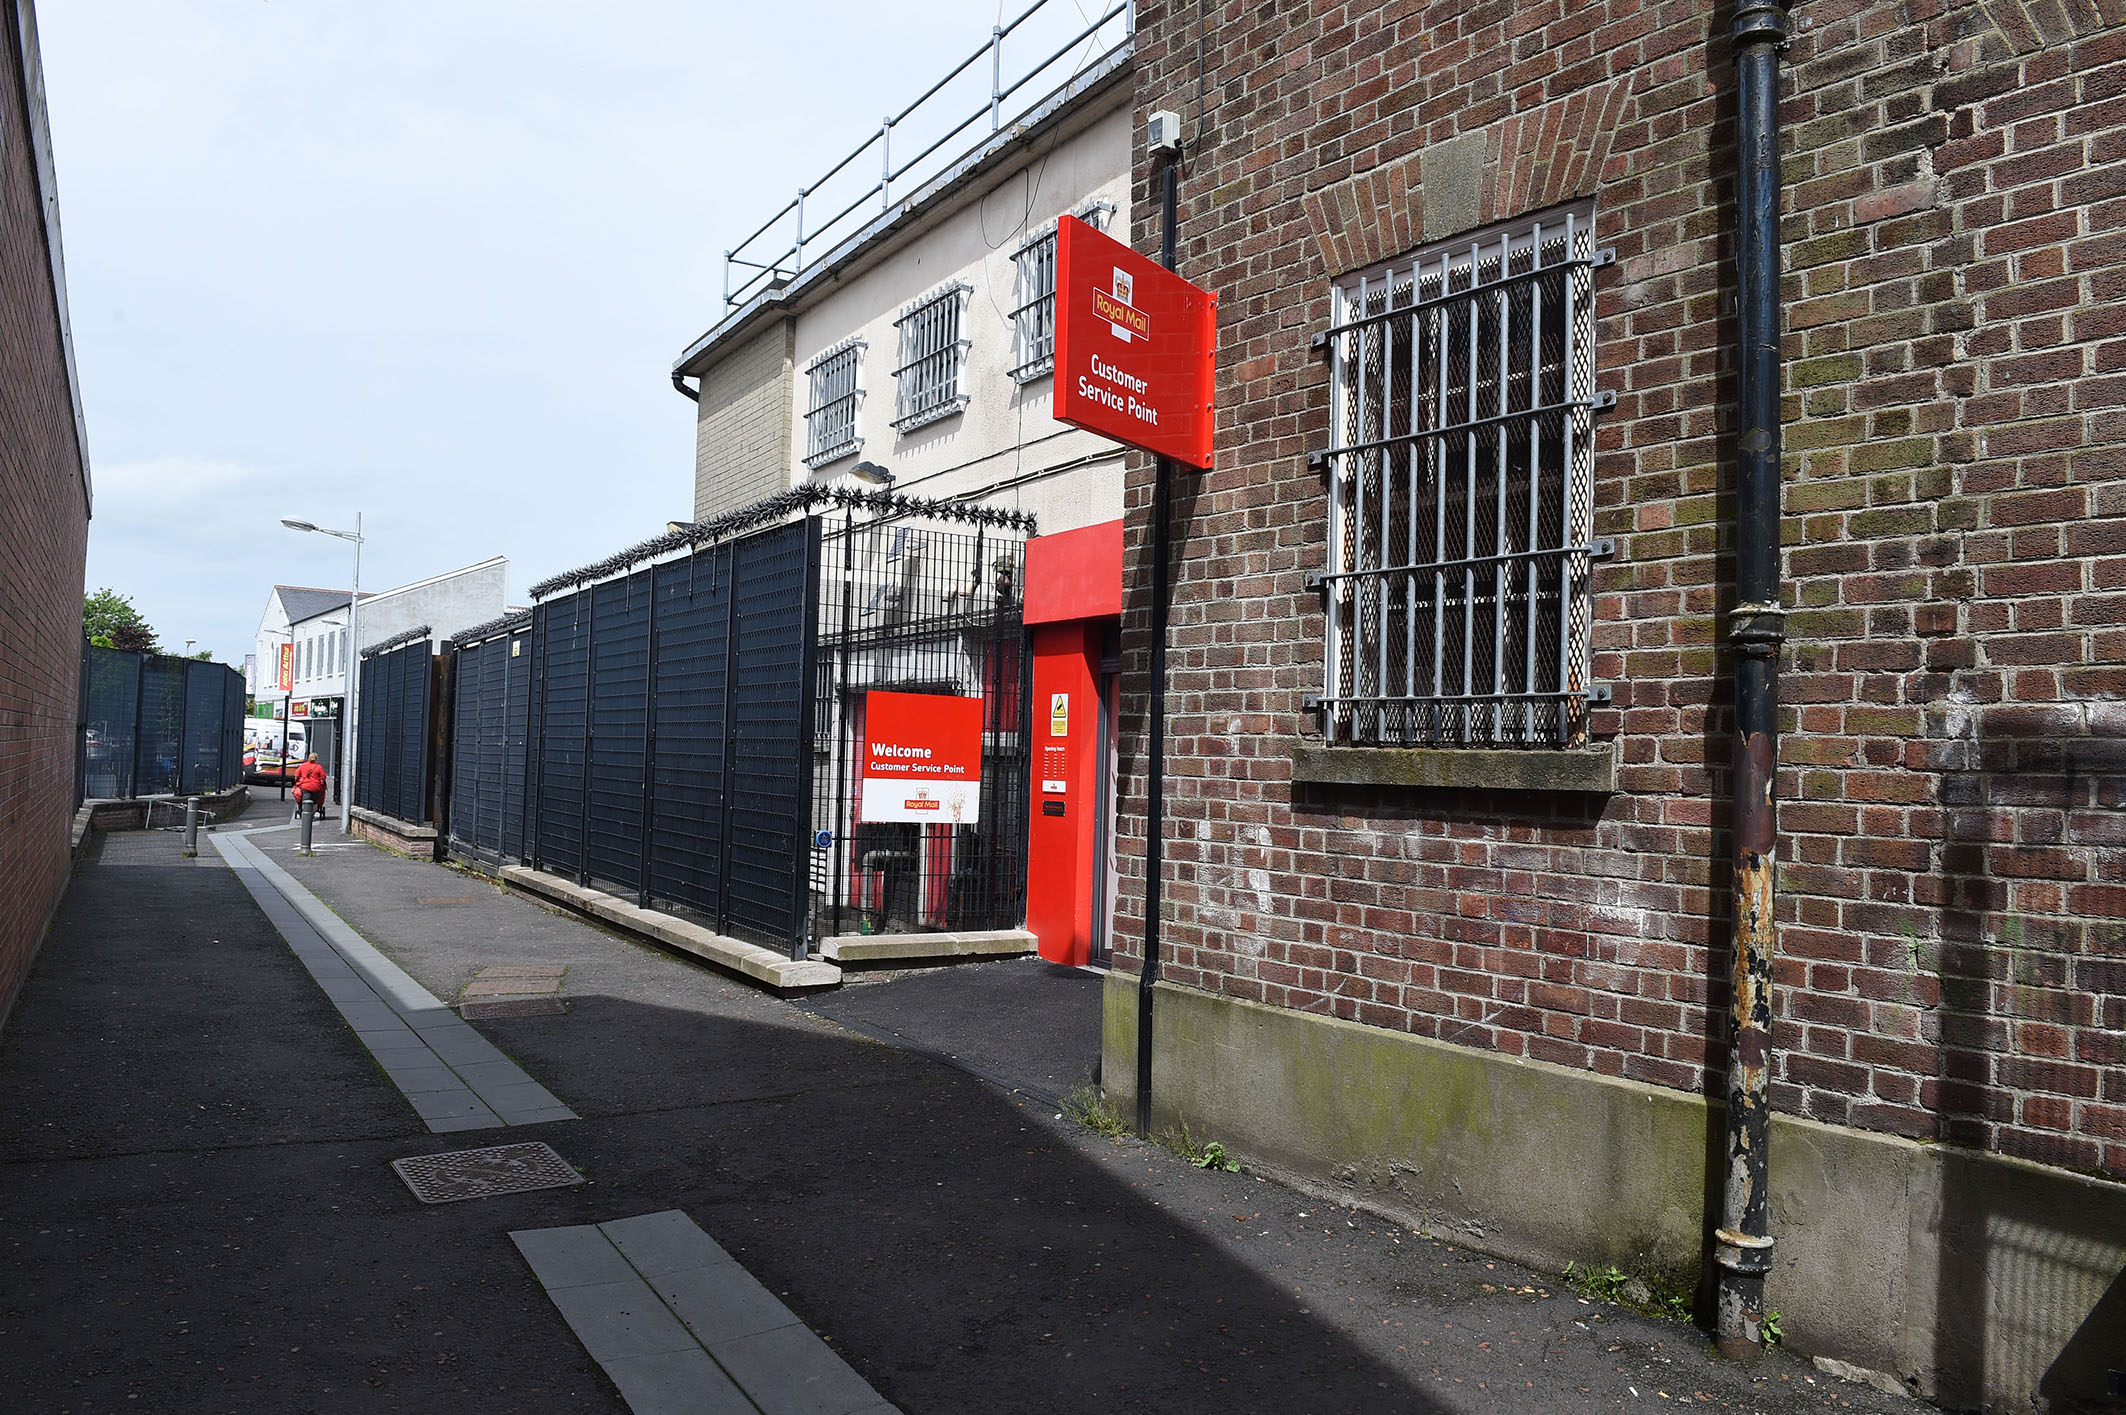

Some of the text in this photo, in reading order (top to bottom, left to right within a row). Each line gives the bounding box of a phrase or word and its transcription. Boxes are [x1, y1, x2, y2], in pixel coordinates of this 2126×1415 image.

[1096, 294, 1146, 332] Royal Mail
[1091, 354, 1148, 396] Customer
[1078, 375, 1158, 426] Service Point
[871, 742, 932, 758] Welcome
[870, 761, 965, 774] Customer Service Point
[906, 800, 924, 809] Royal
